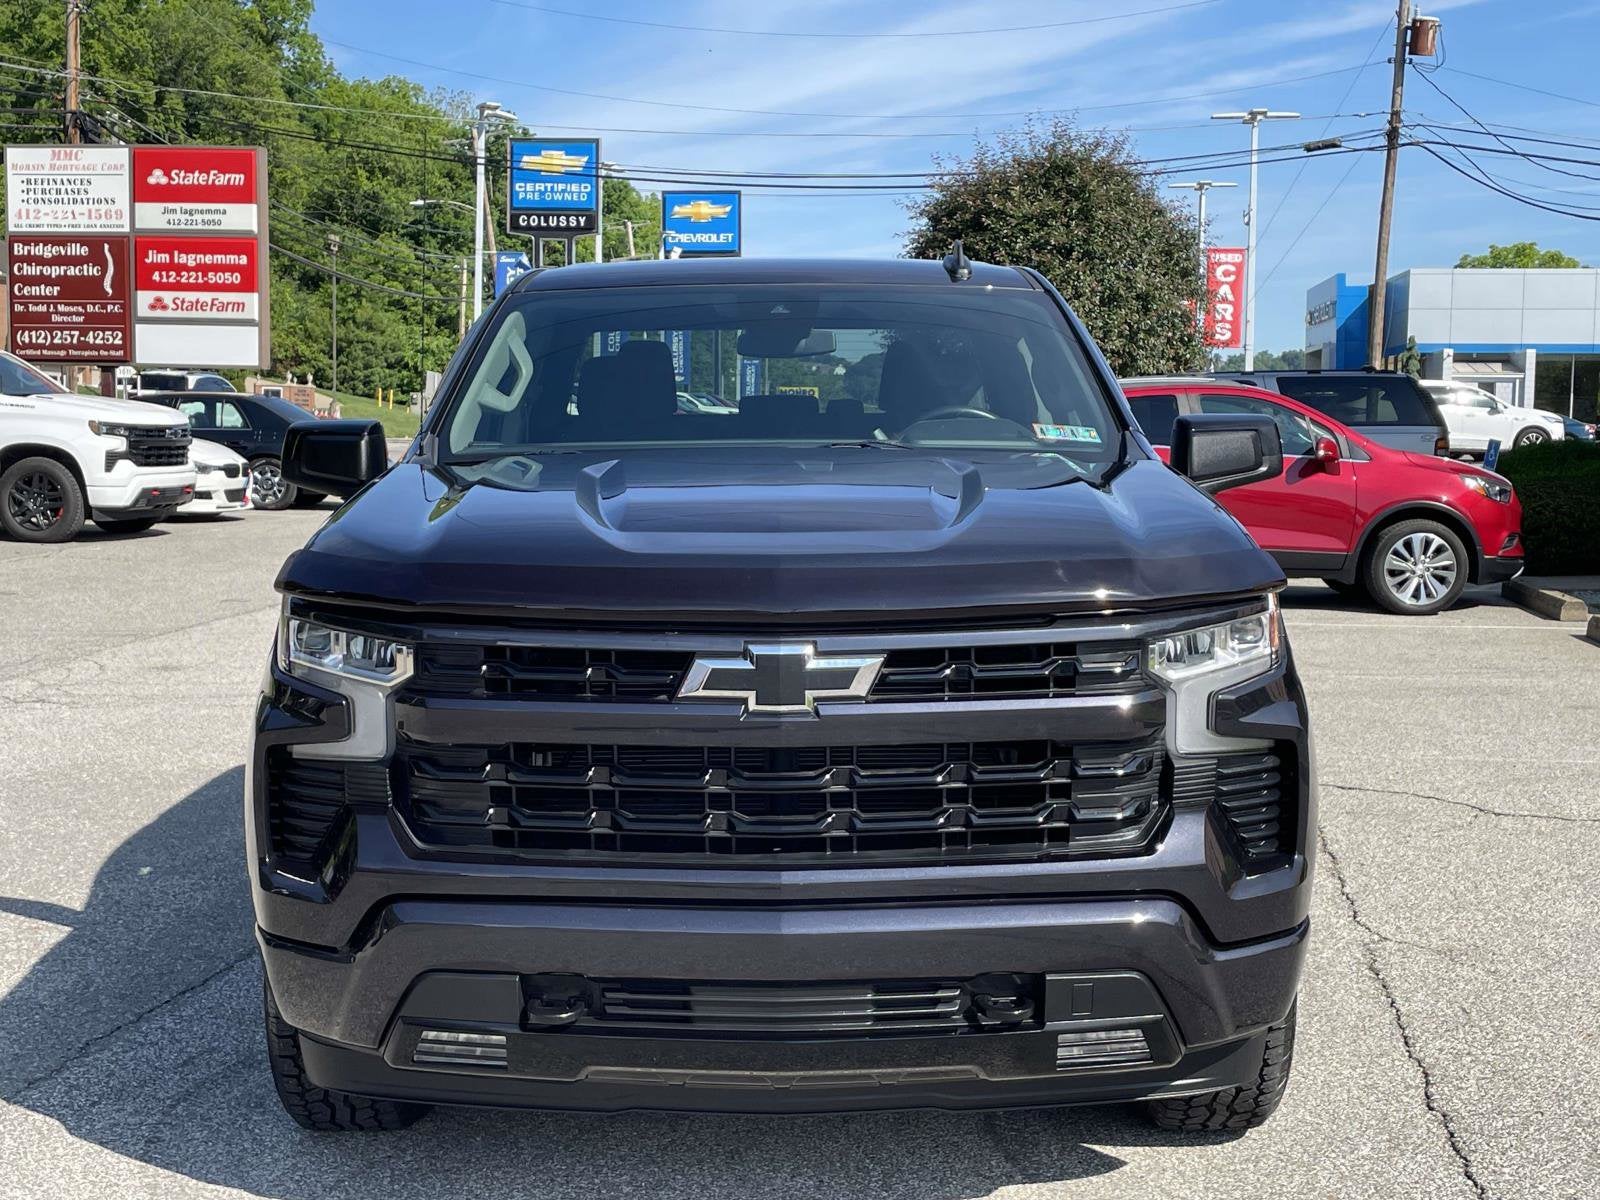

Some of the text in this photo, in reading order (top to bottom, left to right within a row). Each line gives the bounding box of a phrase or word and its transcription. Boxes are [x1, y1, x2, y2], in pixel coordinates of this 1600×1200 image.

[50, 150, 83, 161] MMC
[48, 163, 97, 171] MORTGAGE
[515, 183, 591, 192] CERTIFIED
[519, 192, 588, 201] PRE-OWNED
[16, 208, 124, 220] 412-221-1569
[161, 206, 227, 217] Jim Iagnemma
[166, 218, 222, 227] 412-221-5050
[519, 215, 587, 227] COLUSSY
[668, 233, 734, 243] CHEVROLET
[13, 243, 88, 258] Bridgeville
[144, 250, 248, 267] Jim Iagnemma
[1210, 253, 1243, 263] USED
[13, 263, 101, 278] Chiropractic
[152, 271, 241, 284] 412-221-5050
[13, 283, 61, 297] Center
[1214, 264, 1236, 341] CARS
[14, 304, 27, 312] Dr.
[28, 304, 47, 312] Todd
[49, 304, 56, 313] J.
[57, 304, 85, 313] Moses,
[51, 314, 85, 323] Director
[16, 330, 123, 346] (412) 257-4252
[42, 349, 67, 357] Massage
[69, 349, 98, 357] Therapists
